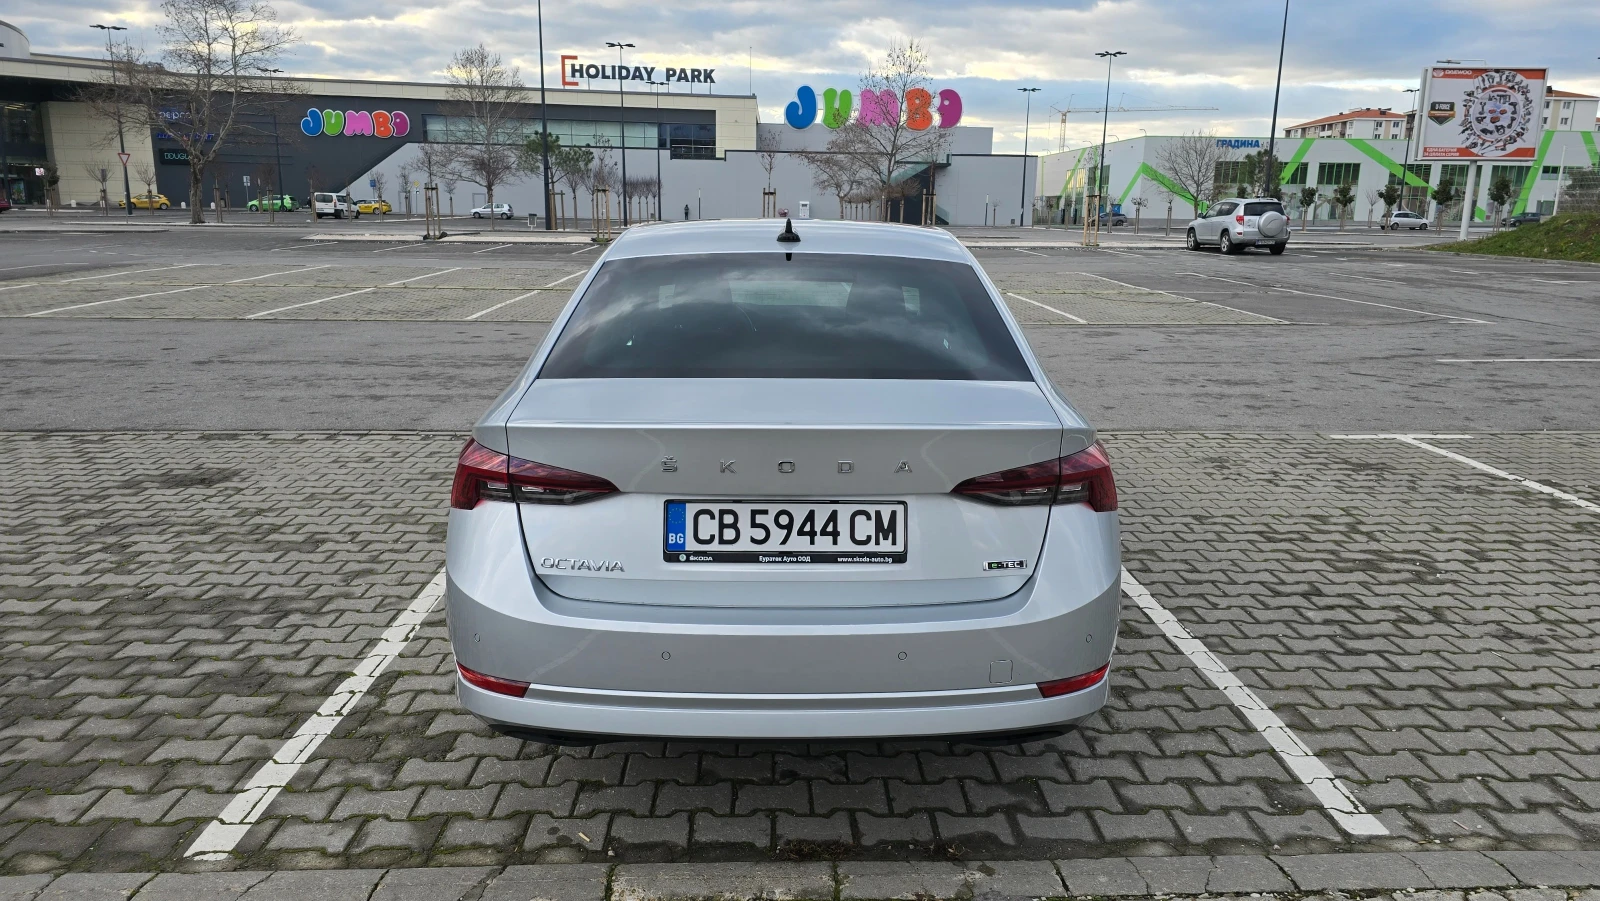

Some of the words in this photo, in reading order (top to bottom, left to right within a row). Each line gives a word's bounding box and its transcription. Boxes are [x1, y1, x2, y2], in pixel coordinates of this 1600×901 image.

[571, 63, 656, 81] HOLIDAY
[665, 67, 716, 83] PARK
[784, 84, 963, 131] JUMBO
[301, 107, 410, 139] JUMBO
[1216, 139, 1260, 149] ГРАДИНА
[660, 456, 913, 474] ŠKODA
[693, 508, 741, 546] CB
[750, 508, 840, 546] 5944
[849, 509, 897, 546] CM
[669, 533, 684, 544] BG
[541, 556, 625, 572] OCTAVIA
[991, 561, 1021, 569] e-TEC
